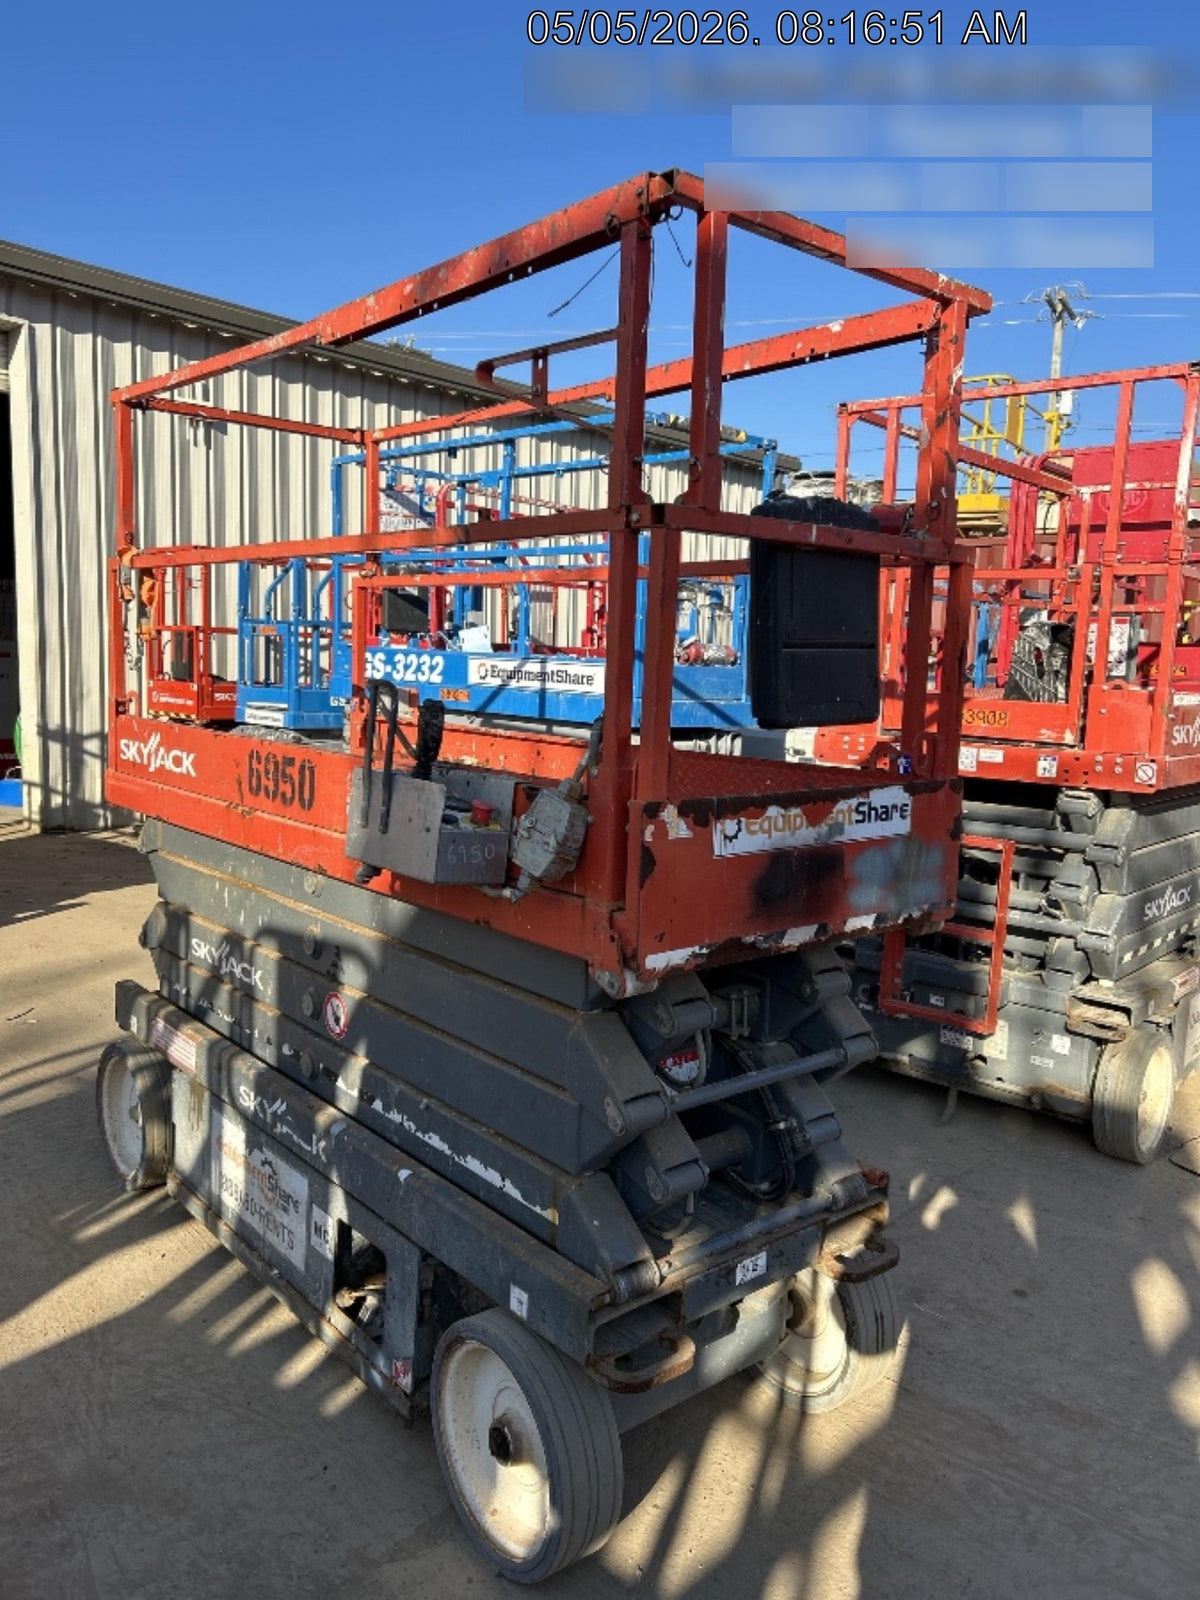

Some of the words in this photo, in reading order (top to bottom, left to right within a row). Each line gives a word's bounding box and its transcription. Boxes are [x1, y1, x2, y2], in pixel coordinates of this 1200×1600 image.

[490, 664, 595, 686] EquipmentShare
[119, 732, 196, 777] SKYJACK
[248, 749, 316, 811] 6950
[744, 801, 909, 839] equipentShare
[191, 938, 264, 991] SKYJACK
